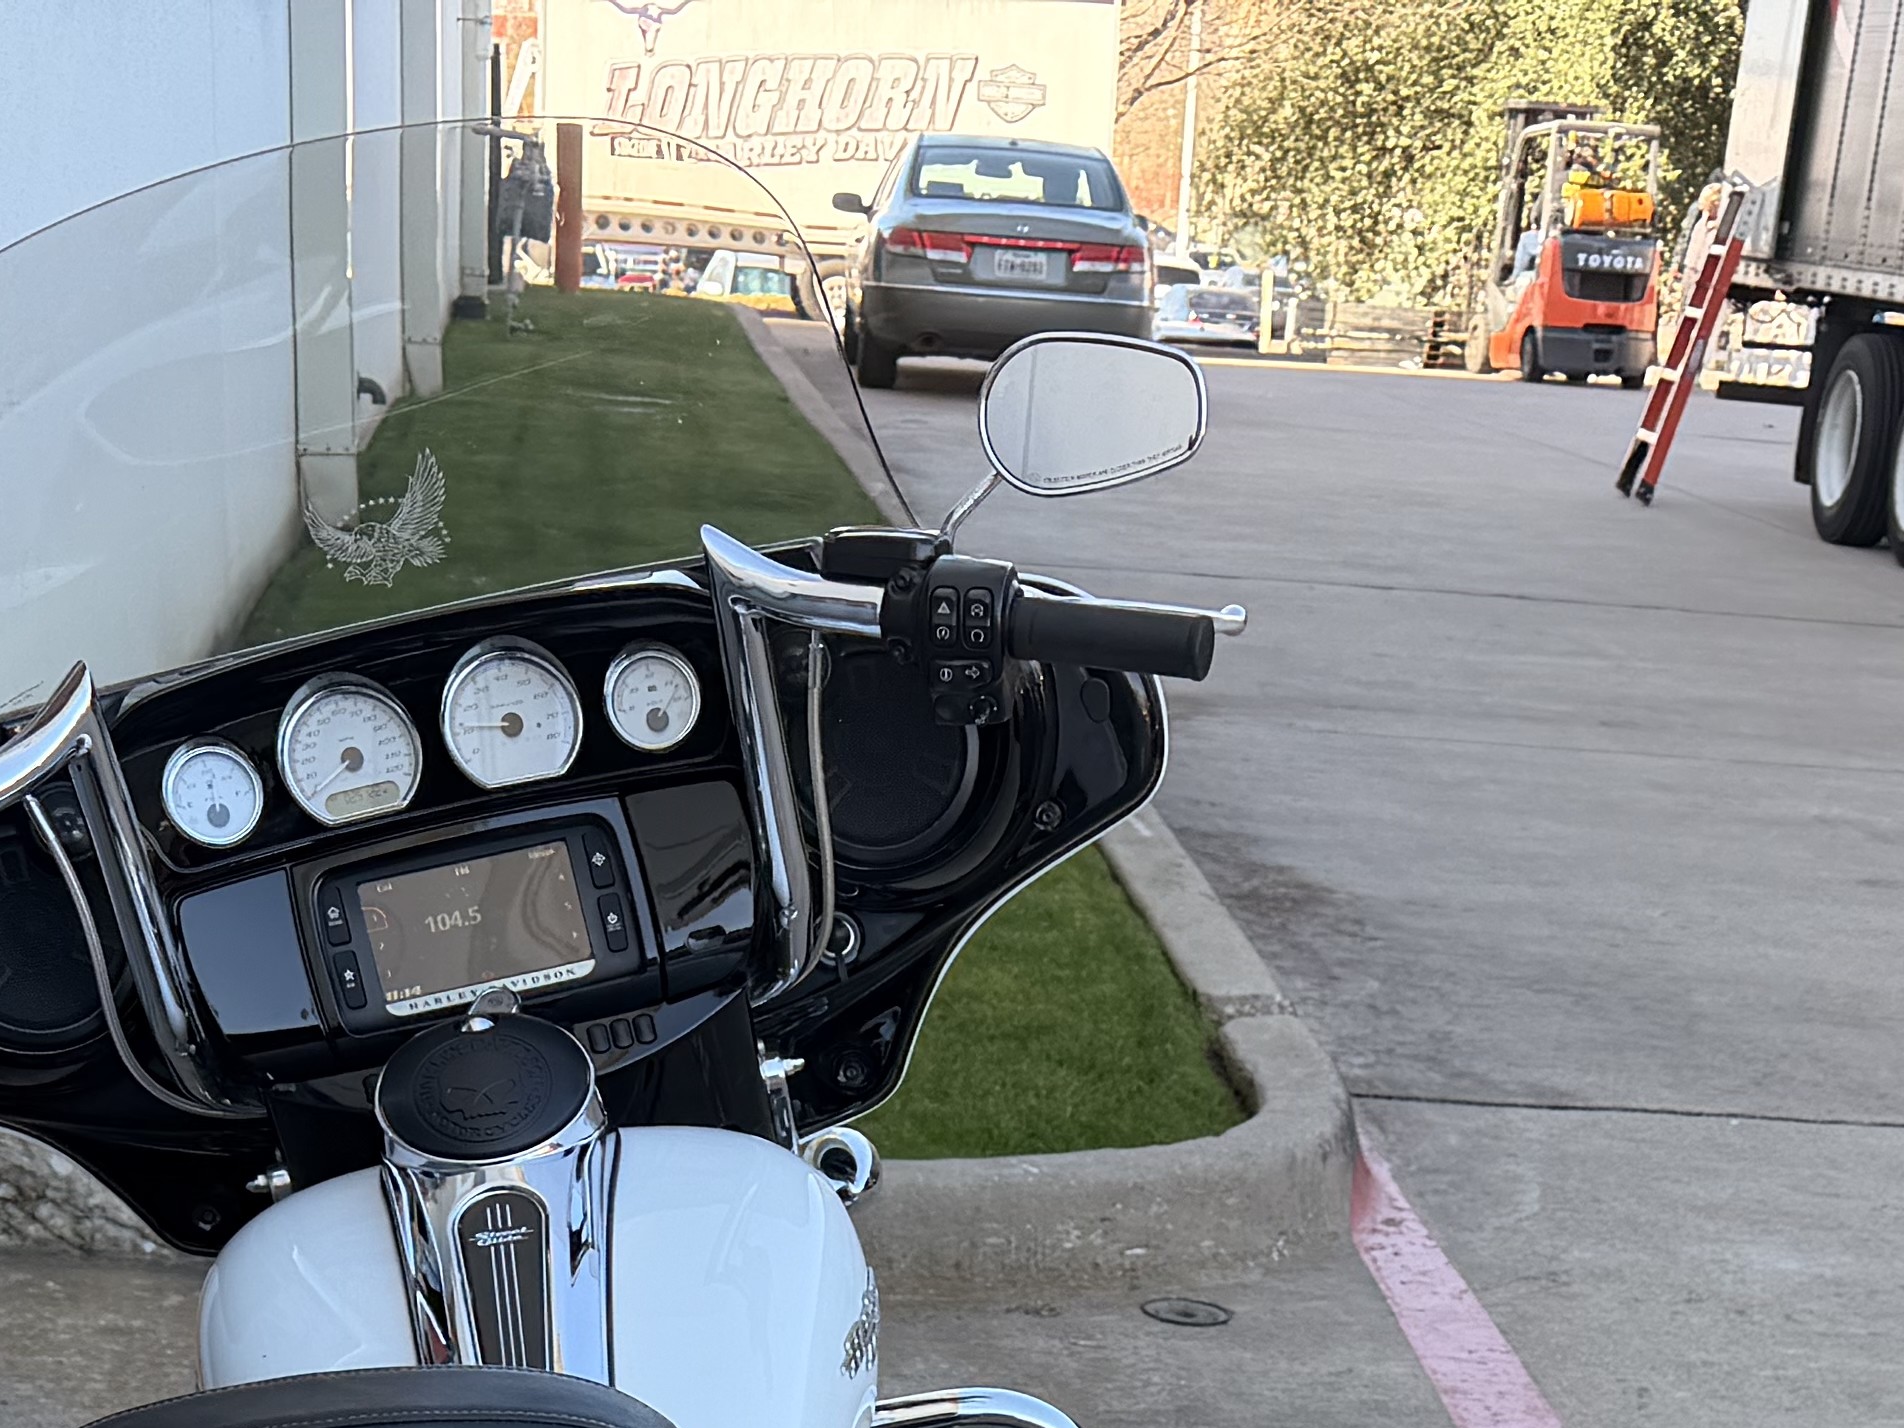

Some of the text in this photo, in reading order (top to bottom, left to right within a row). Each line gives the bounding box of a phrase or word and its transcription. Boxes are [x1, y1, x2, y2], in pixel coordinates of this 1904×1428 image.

[590, 54, 978, 139] LONGHORN
[1576, 253, 1644, 269] TOYOTA
[424, 906, 482, 933] 104.5
[409, 967, 576, 1010] HARLEYVIDSON
